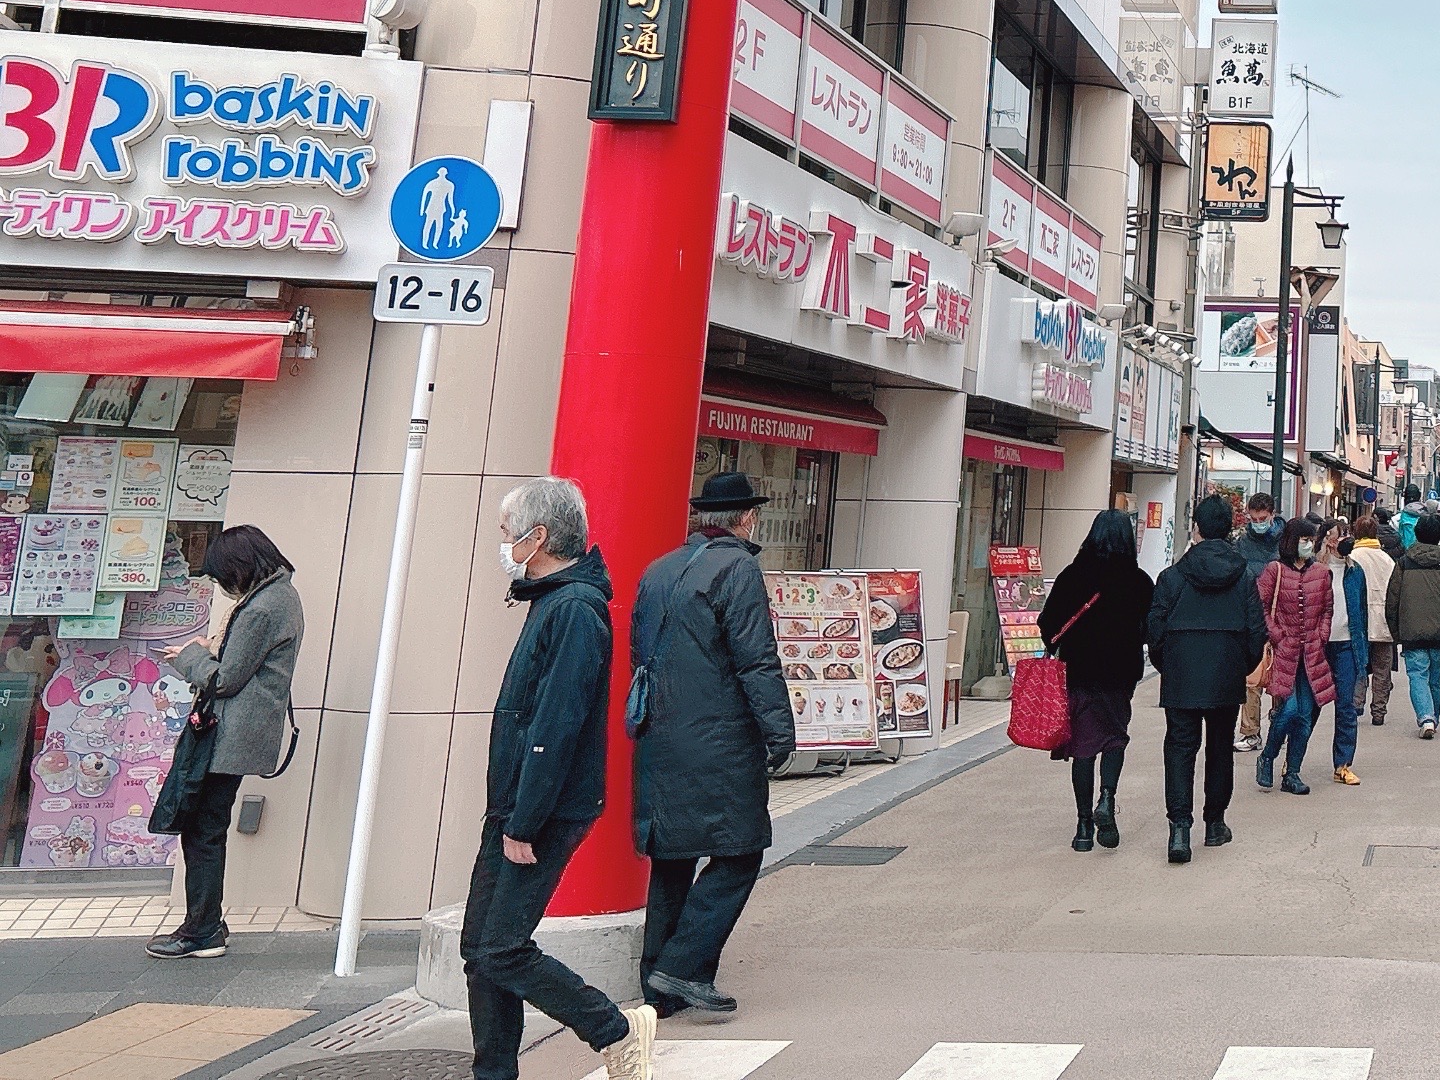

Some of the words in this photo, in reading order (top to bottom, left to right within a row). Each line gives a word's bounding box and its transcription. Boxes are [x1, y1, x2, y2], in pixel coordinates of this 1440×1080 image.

[736, 18, 767, 72] 2F
[1232, 42, 1268, 55] 北海道
[173, 73, 372, 137] baskin
[811, 65, 873, 136] レストラン
[1228, 96, 1253, 109] B1F
[167, 137, 372, 192] robbins
[1211, 158, 1258, 200] わん
[148, 201, 337, 248] アイスクリーム
[1002, 198, 1017, 232] 2F
[727, 196, 814, 280] レストラン
[1071, 242, 1096, 280] レストラン
[387, 274, 484, 313] 12-16
[935, 281, 973, 341] 洋菓子
[709, 409, 748, 433] FUJIYA
[751, 416, 815, 442] RESTAURANT
[128, 601, 206, 613] ロディとクロミの
[131, 613, 199, 626] ートクリスマス
